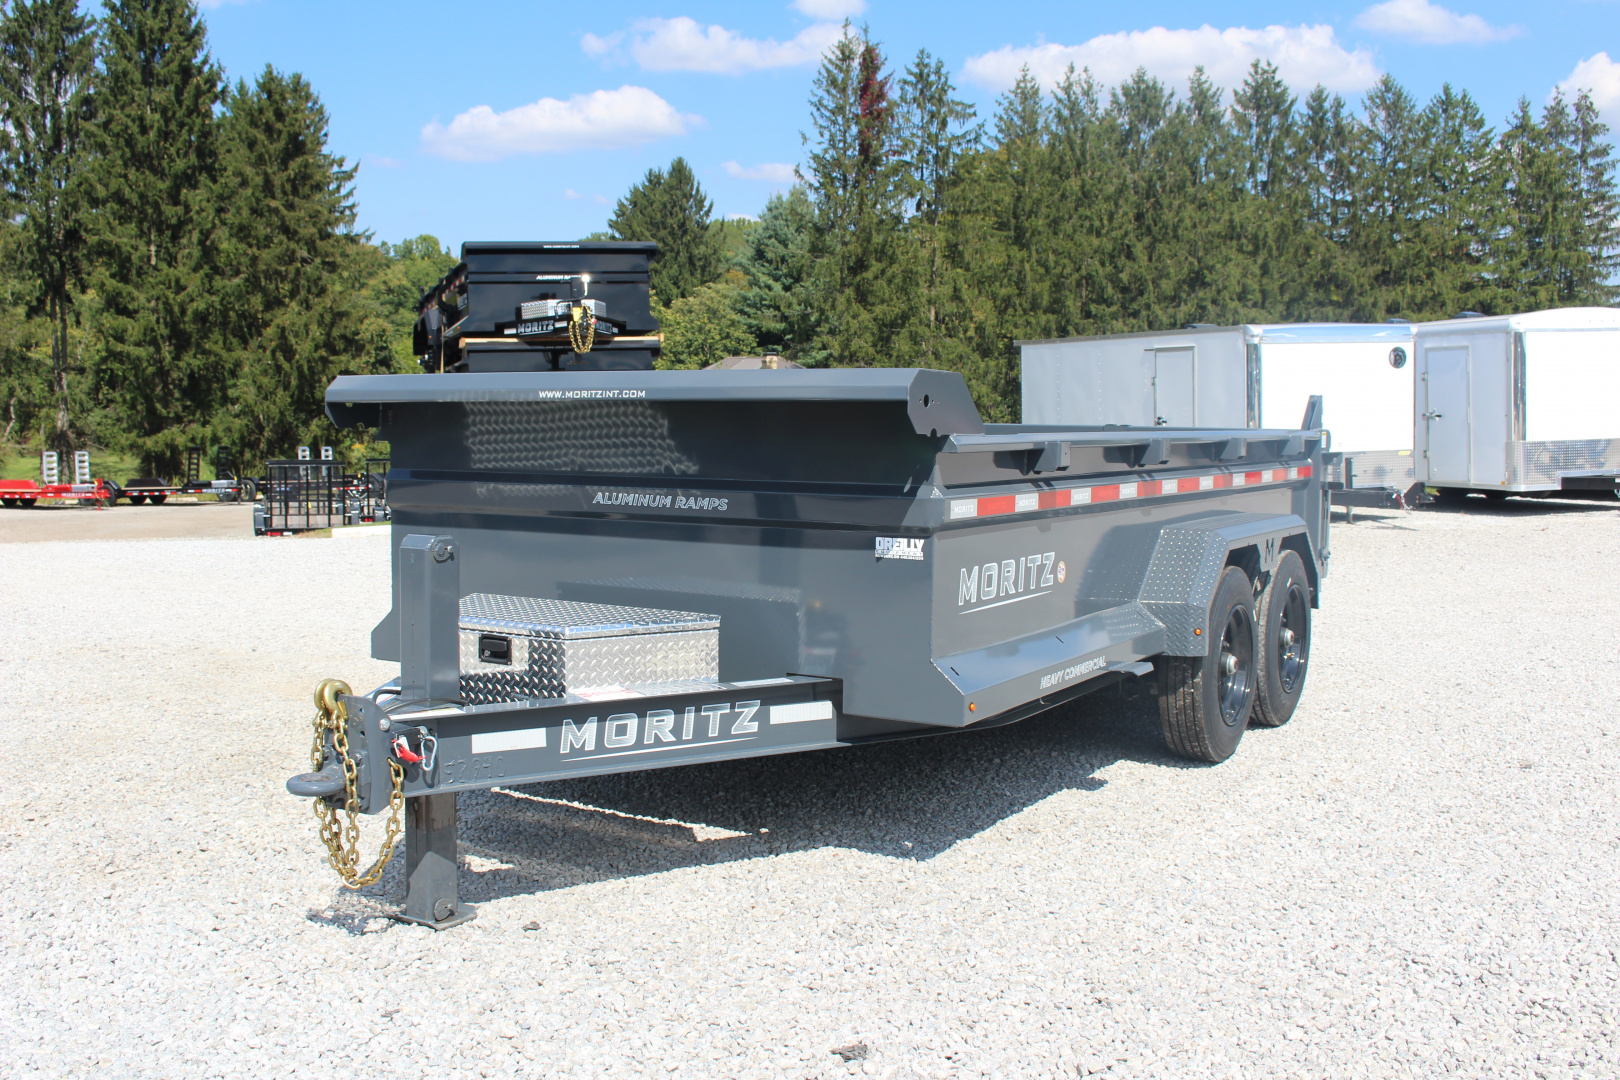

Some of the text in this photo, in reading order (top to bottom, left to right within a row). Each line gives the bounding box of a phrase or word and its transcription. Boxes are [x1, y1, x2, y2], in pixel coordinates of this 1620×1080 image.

[518, 320, 554, 333] MORITZ
[538, 390, 646, 398] WWW.MORITZINT.COM
[592, 491, 729, 511] ALUMINUM RAMPS
[953, 504, 974, 514] MORITZ
[958, 552, 1055, 606] MORITZ
[1040, 656, 1106, 690] HEAVY COMMERCIAL
[560, 700, 761, 754] MORITZ
